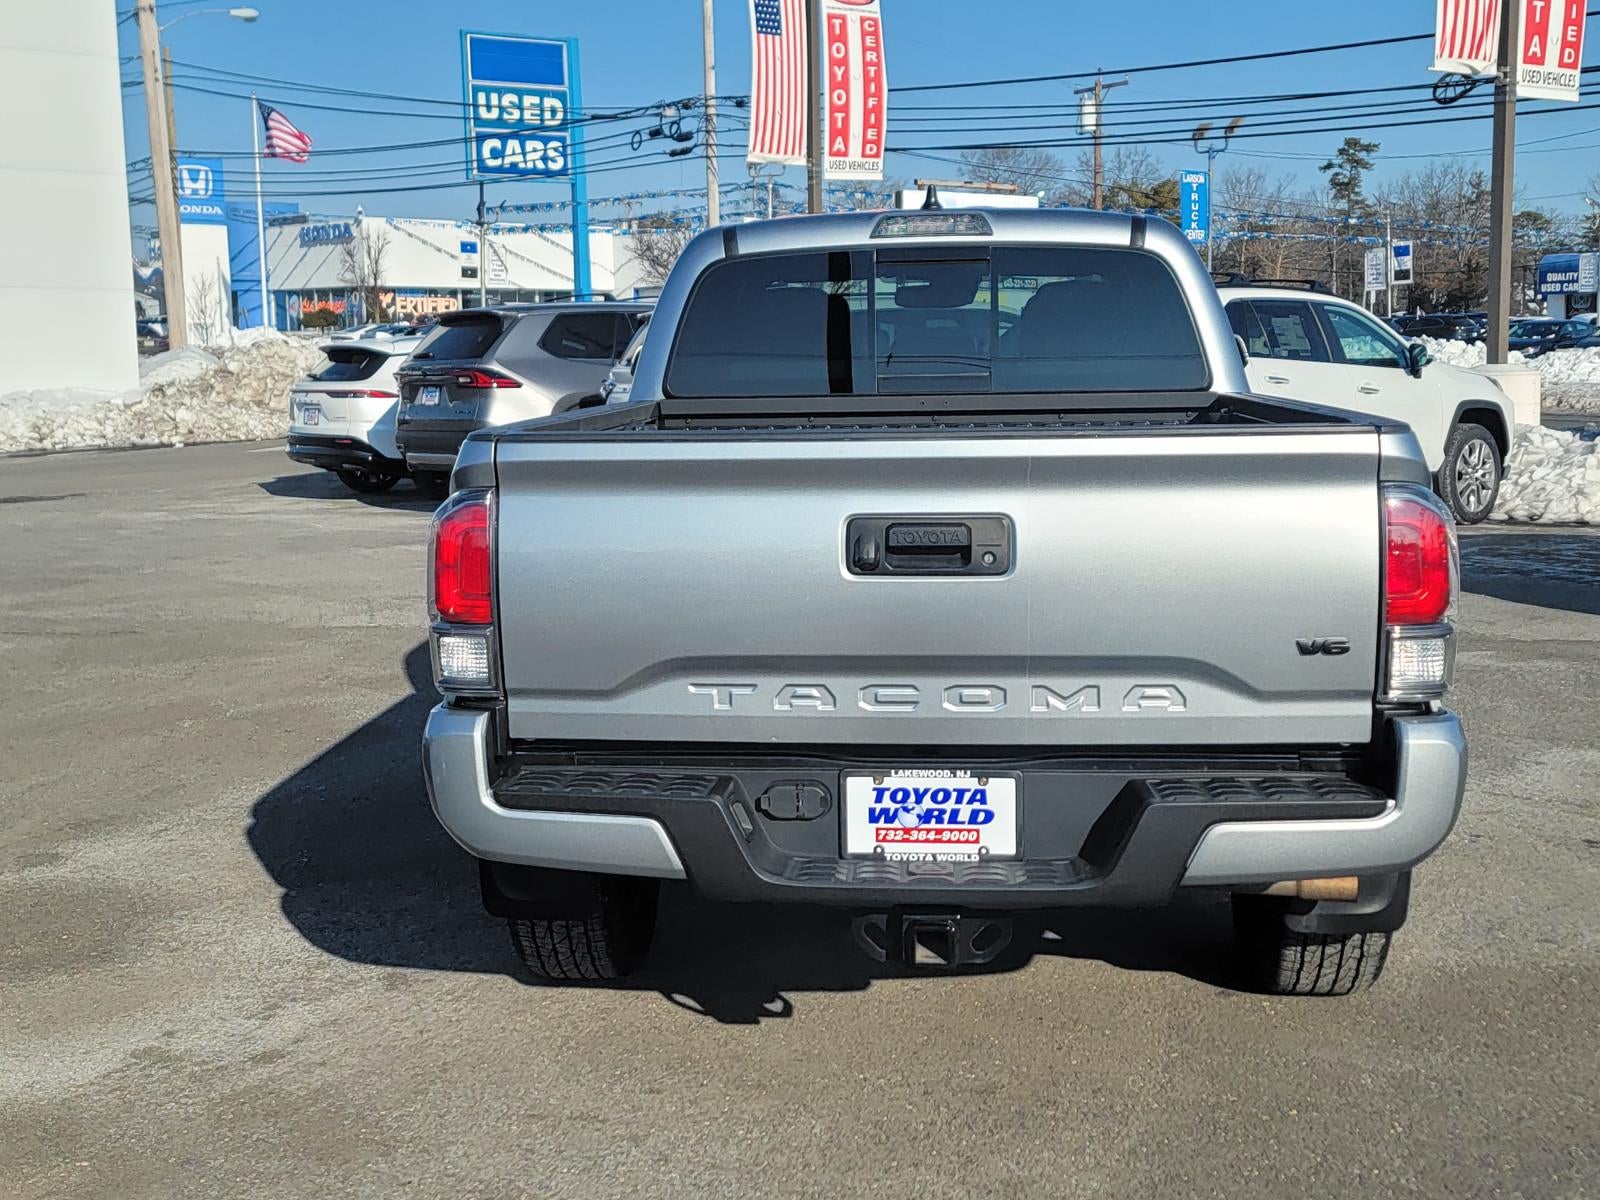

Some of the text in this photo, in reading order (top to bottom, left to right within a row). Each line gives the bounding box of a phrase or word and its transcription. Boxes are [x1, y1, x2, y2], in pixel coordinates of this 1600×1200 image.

[831, 18, 847, 153] TOYOTA
[1521, 68, 1577, 88] USED VEHICLES
[863, 20, 879, 155] CERTIFIED
[477, 91, 565, 126] USED
[482, 137, 565, 171] CARS
[829, 160, 880, 171] USED VEHICLES
[180, 204, 224, 215] ONDA
[1190, 183, 1199, 229] TRUCK
[299, 222, 355, 246] HONDA
[1546, 271, 1579, 282] QUALITY
[1541, 282, 1562, 293] USED
[892, 529, 964, 545] TOYOTA
[1295, 637, 1351, 656] V6
[687, 683, 1187, 713] TACOMA
[956, 769, 971, 778] NJ
[872, 787, 988, 805] TOYOTA
[877, 829, 978, 842] 732-364-9000
[884, 853, 980, 862] TOYOTA WORLD
